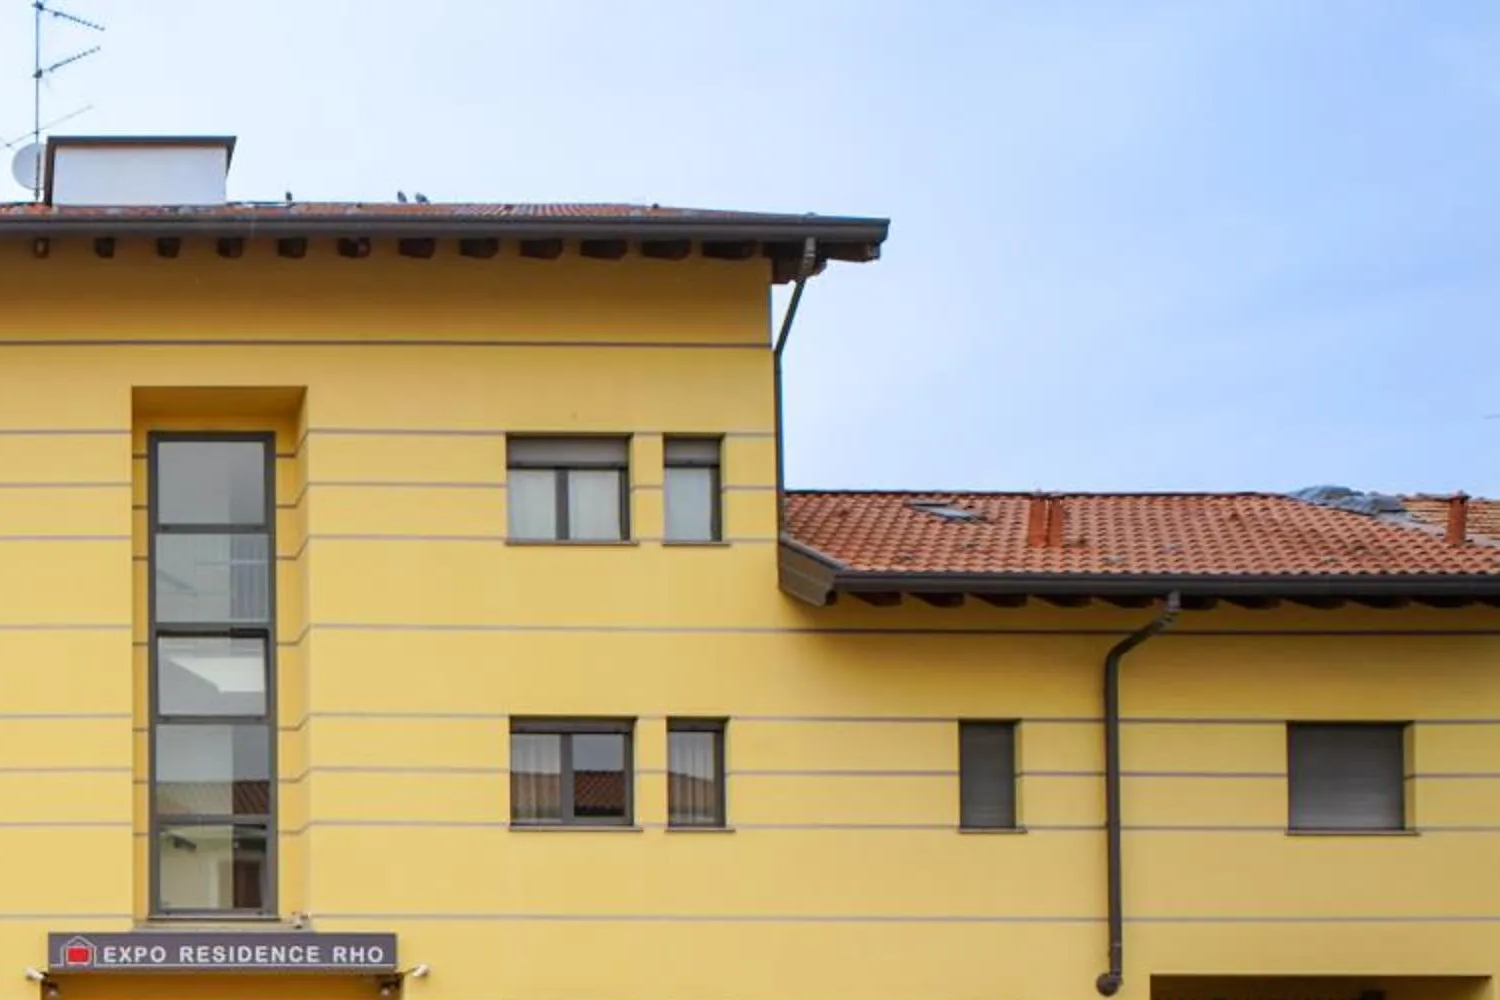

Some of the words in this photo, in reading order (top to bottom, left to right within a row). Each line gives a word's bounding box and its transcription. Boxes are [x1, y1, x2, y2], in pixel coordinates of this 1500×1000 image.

[103, 946, 166, 963] EXPO
[179, 946, 320, 964] RESIDENCE
[332, 946, 384, 963] RHO
